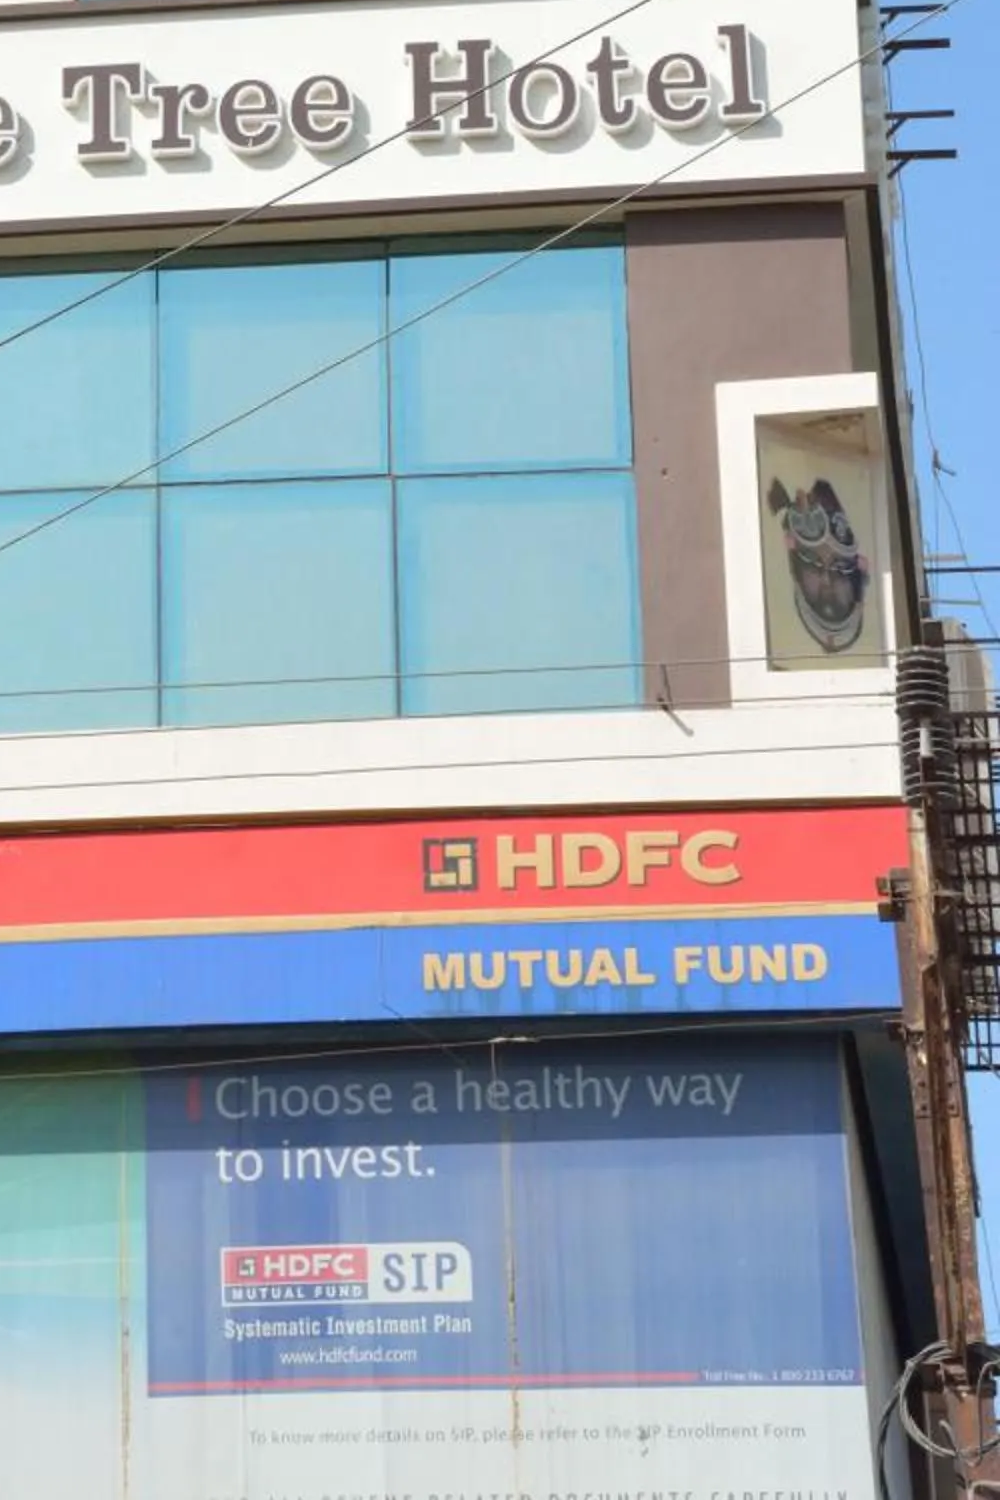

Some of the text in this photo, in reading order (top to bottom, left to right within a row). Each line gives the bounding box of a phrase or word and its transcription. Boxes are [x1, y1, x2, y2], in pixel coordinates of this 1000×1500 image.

[62, 62, 352, 158] Tree
[404, 23, 765, 133] Hotel
[496, 829, 742, 890] HDFC
[422, 943, 828, 991] MUTUAL FUND
[215, 1065, 744, 1120] Choose a healthy way
[215, 1140, 436, 1183] to invest.
[263, 1252, 356, 1279] HDFC
[382, 1252, 459, 1293] SIP
[230, 1284, 364, 1301] MUTUAL FUND
[223, 1313, 473, 1342] Systematic Investment Plan
[249, 1429, 268, 1446] To
[271, 1428, 315, 1445] know
[319, 1431, 362, 1445] more
[425, 1430, 446, 1442] on
[582, 1425, 600, 1441] to
[605, 1423, 631, 1441] the
[666, 1421, 759, 1440] Enrollment
[763, 1421, 807, 1439] Form
